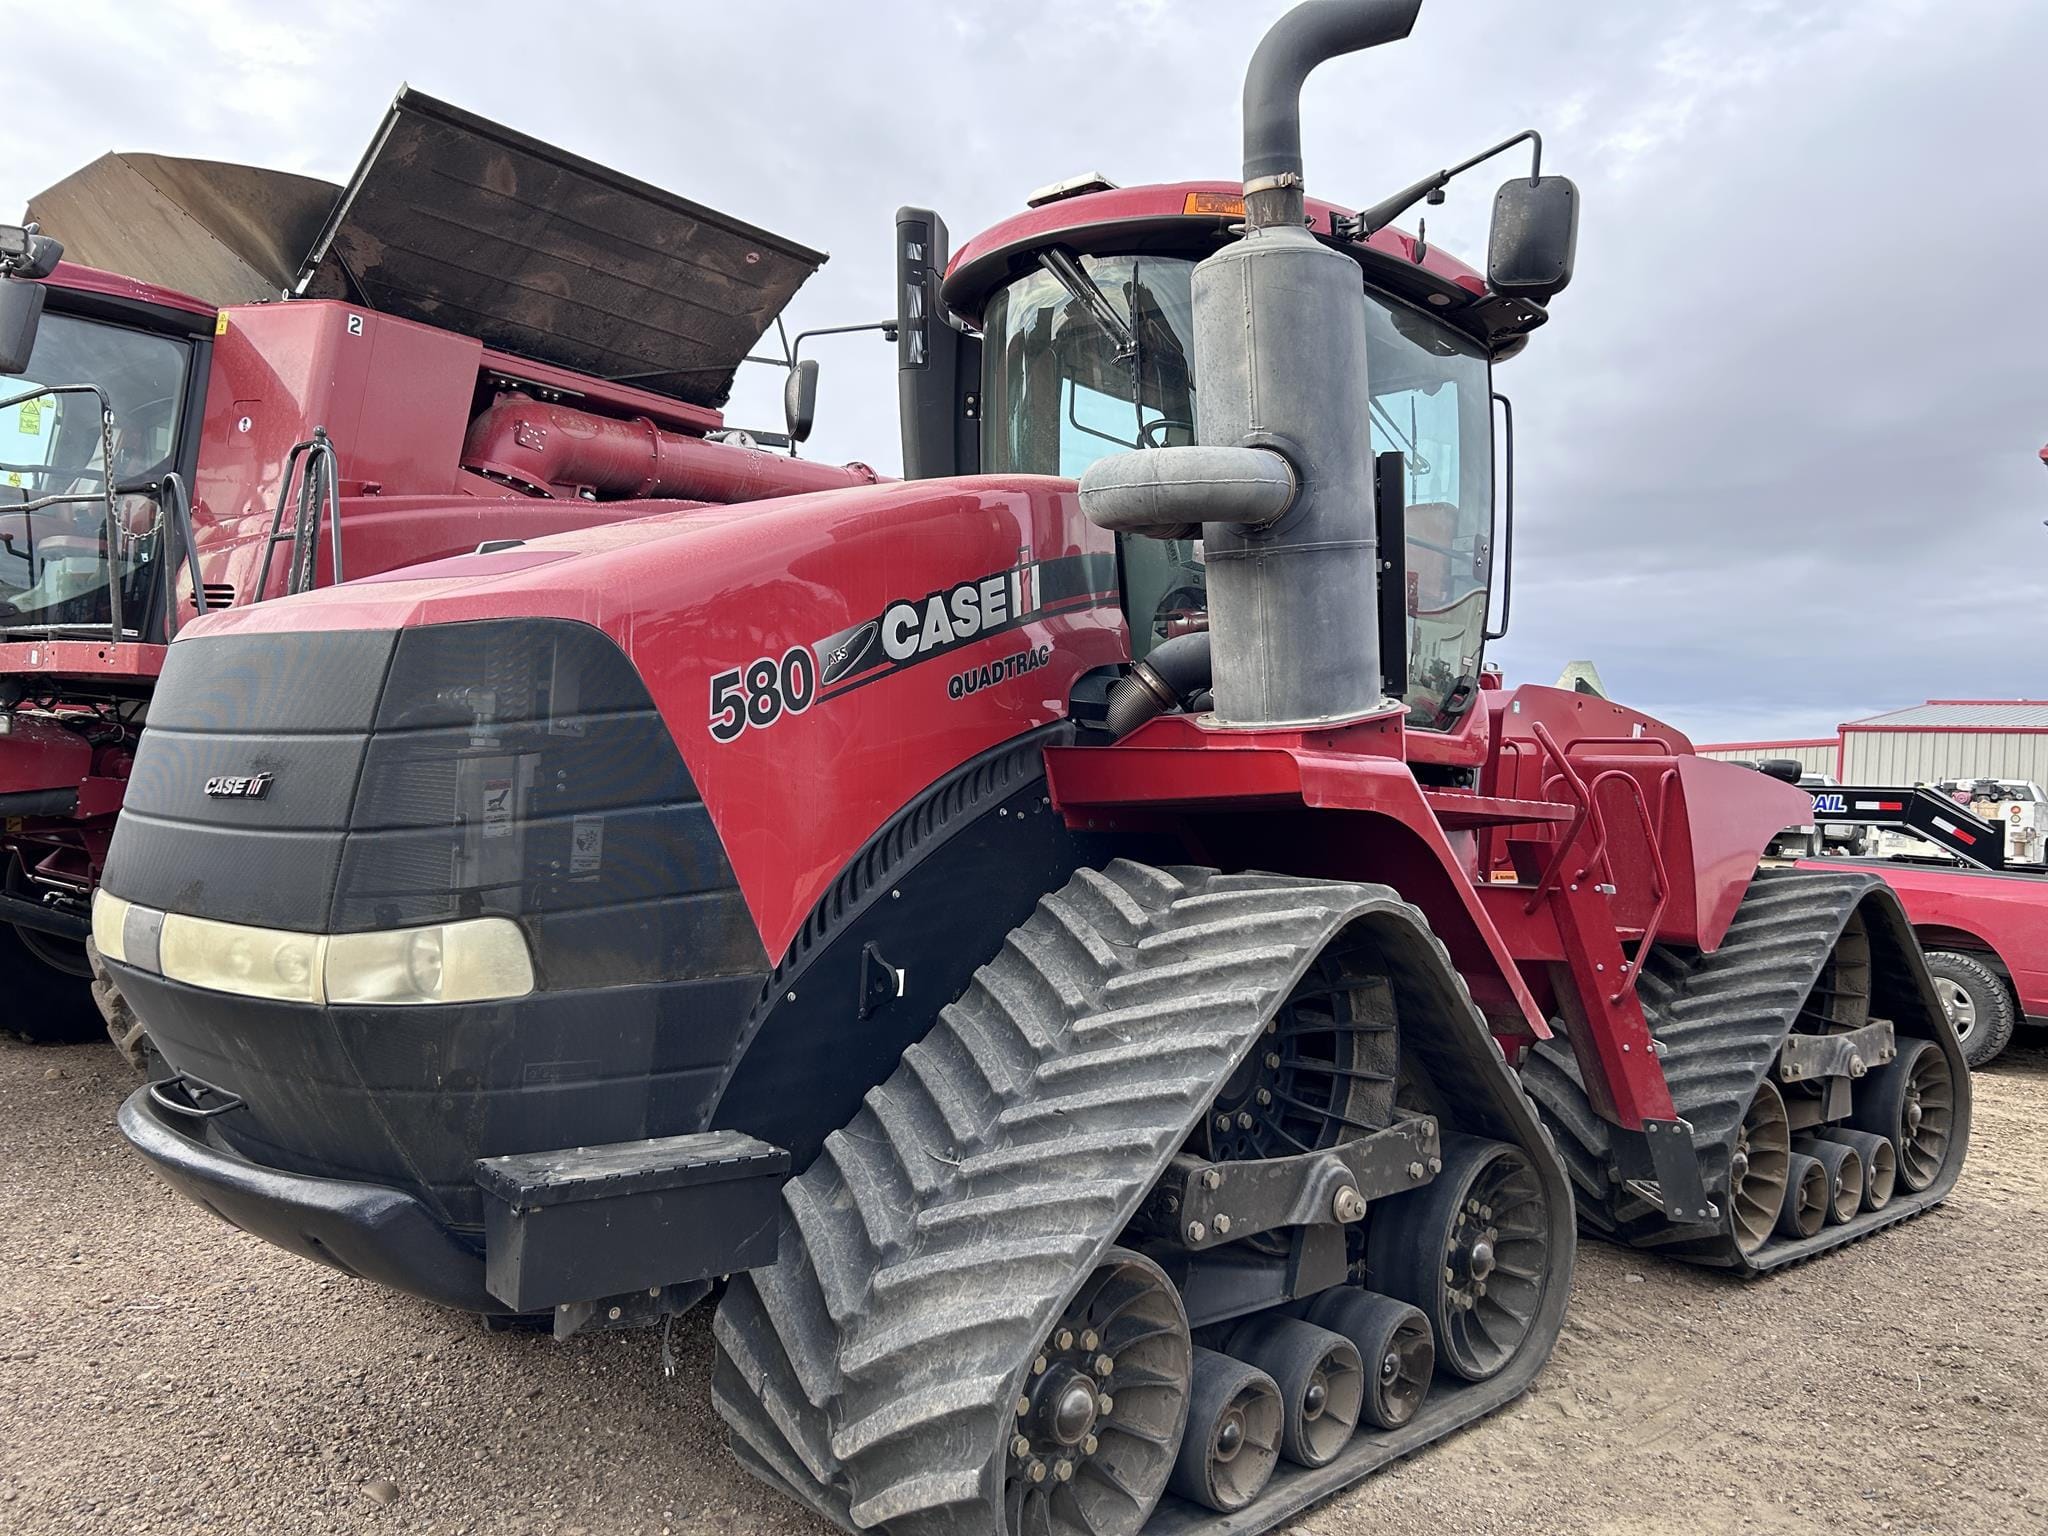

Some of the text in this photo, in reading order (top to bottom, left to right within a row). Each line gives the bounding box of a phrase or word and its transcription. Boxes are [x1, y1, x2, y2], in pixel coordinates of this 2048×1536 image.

[350, 316, 361, 335] 2
[881, 575, 1007, 660] CASE
[827, 645, 848, 666] AFS
[948, 645, 1049, 699] QUADTRAC
[708, 645, 815, 743] 580
[203, 775, 247, 795] CASE
